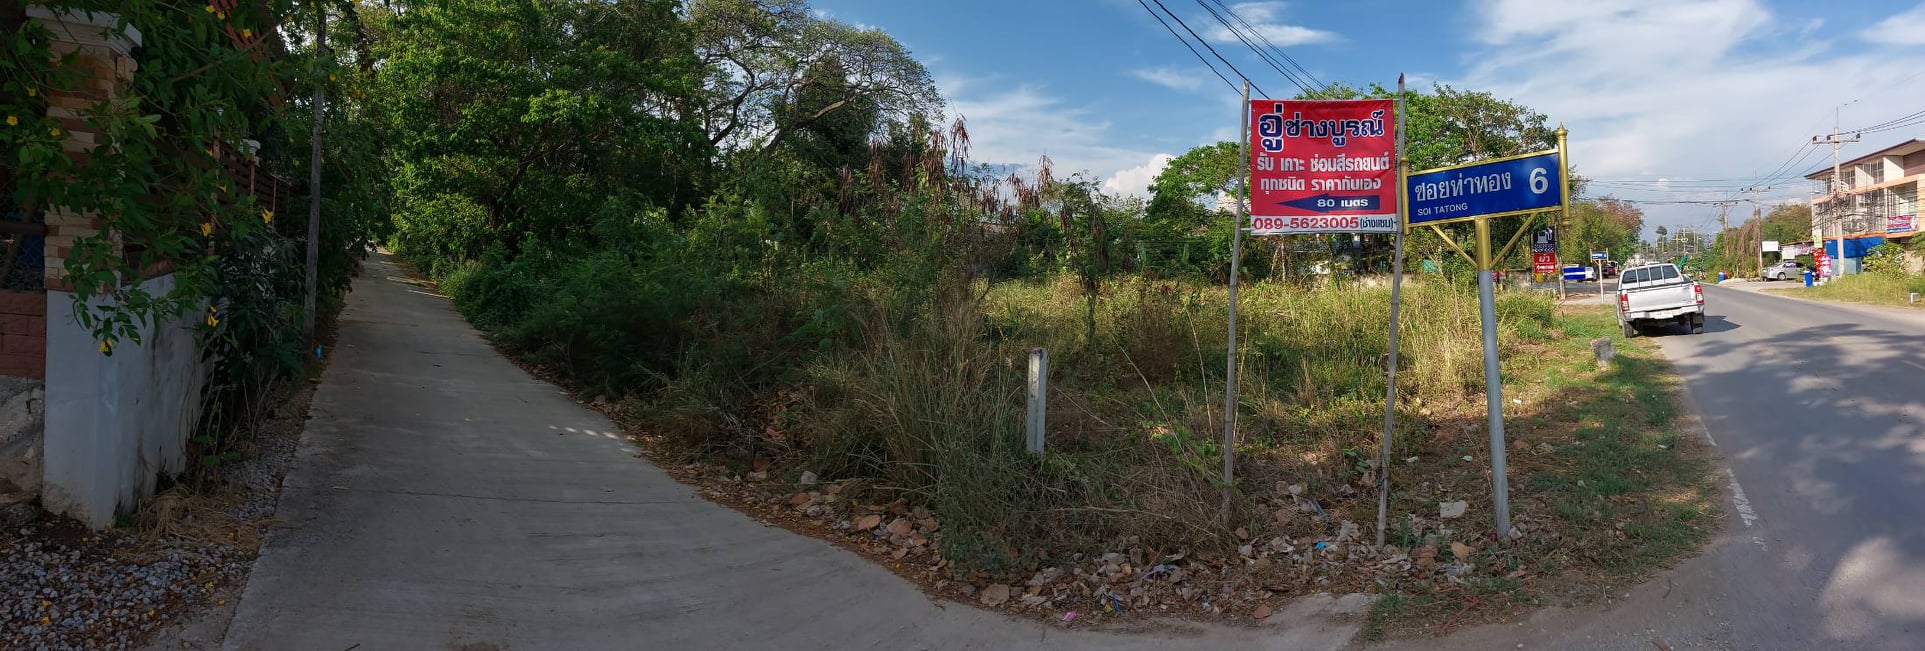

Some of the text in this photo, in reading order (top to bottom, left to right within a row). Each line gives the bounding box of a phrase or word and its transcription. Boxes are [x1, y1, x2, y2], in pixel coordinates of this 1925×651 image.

[1257, 152, 1274, 171] รับ
[1281, 156, 1305, 171] เคาะ
[1260, 175, 1382, 195] ทุกชนิด ราคากันเอง
[1414, 167, 1549, 202] ซอยท่าทอง 6
[1317, 198, 1369, 208] 80 เมตร
[1417, 202, 1468, 216] SOI TATONG
[1253, 217, 1359, 230] 089-5623005
